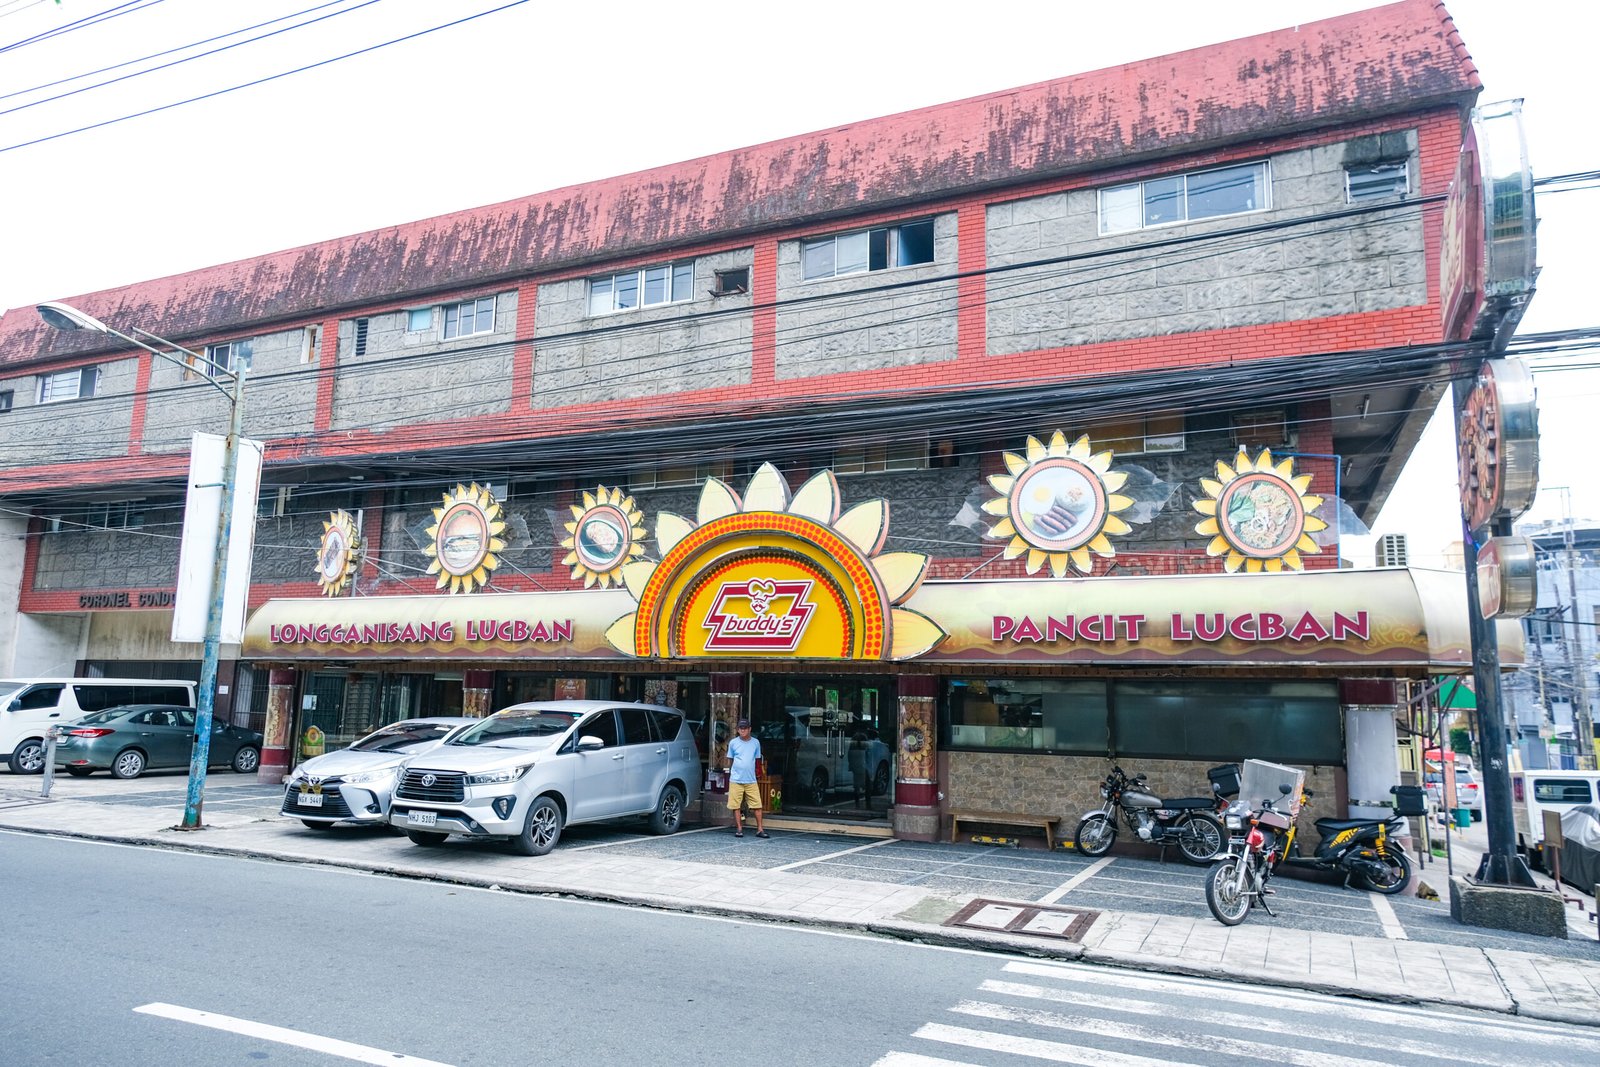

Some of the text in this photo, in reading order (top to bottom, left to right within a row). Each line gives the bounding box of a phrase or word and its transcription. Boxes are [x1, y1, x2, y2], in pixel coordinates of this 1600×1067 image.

[80, 592, 132, 608] CORONEL
[270, 619, 573, 643] LONGGANISANG LUCBAN
[725, 615, 794, 635] buddy's
[991, 610, 1370, 643] PANCIT LUCBAN
